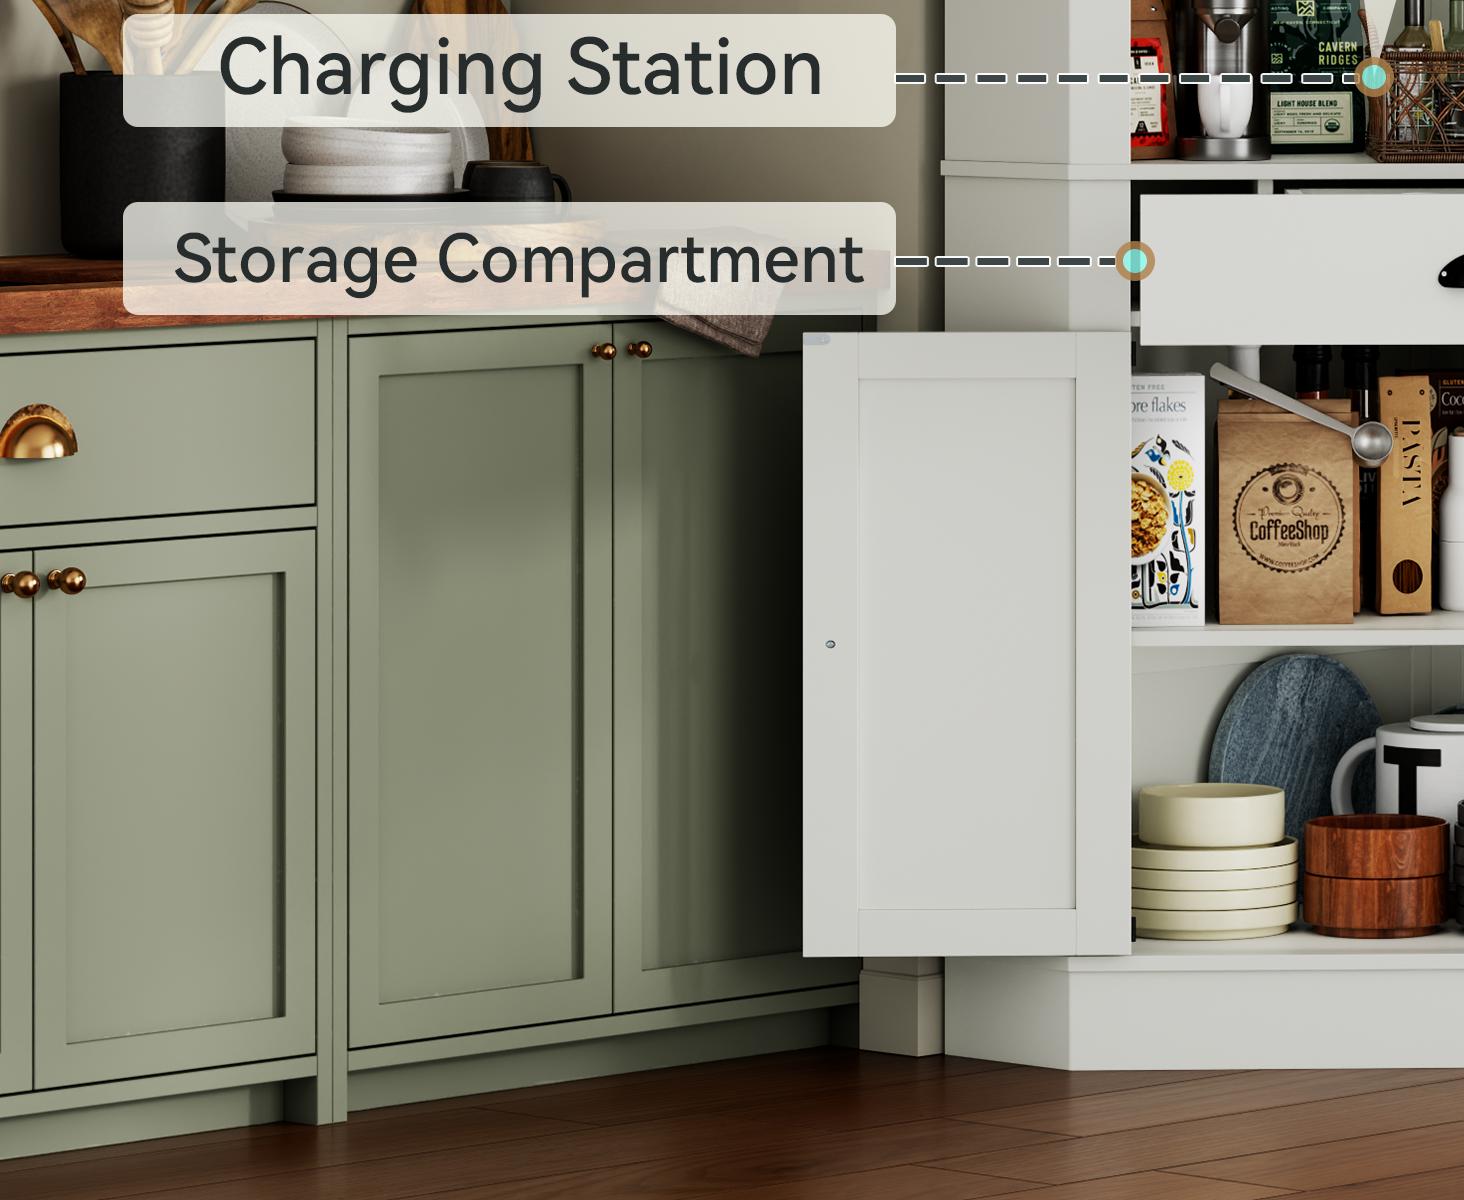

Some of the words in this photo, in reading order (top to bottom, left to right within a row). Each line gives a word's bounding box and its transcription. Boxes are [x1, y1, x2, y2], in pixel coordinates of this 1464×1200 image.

[1318, 41, 1358, 53] CAVERN
[1318, 54, 1359, 66] RIDGES
[1277, 99, 1296, 108] LIGHT
[1297, 99, 1317, 107] HOUSE
[1318, 99, 1338, 107] BLEND
[1151, 396, 1186, 413] flakes
[1402, 420, 1422, 506] PASTA
[1249, 519, 1329, 544] CoffeeShop
